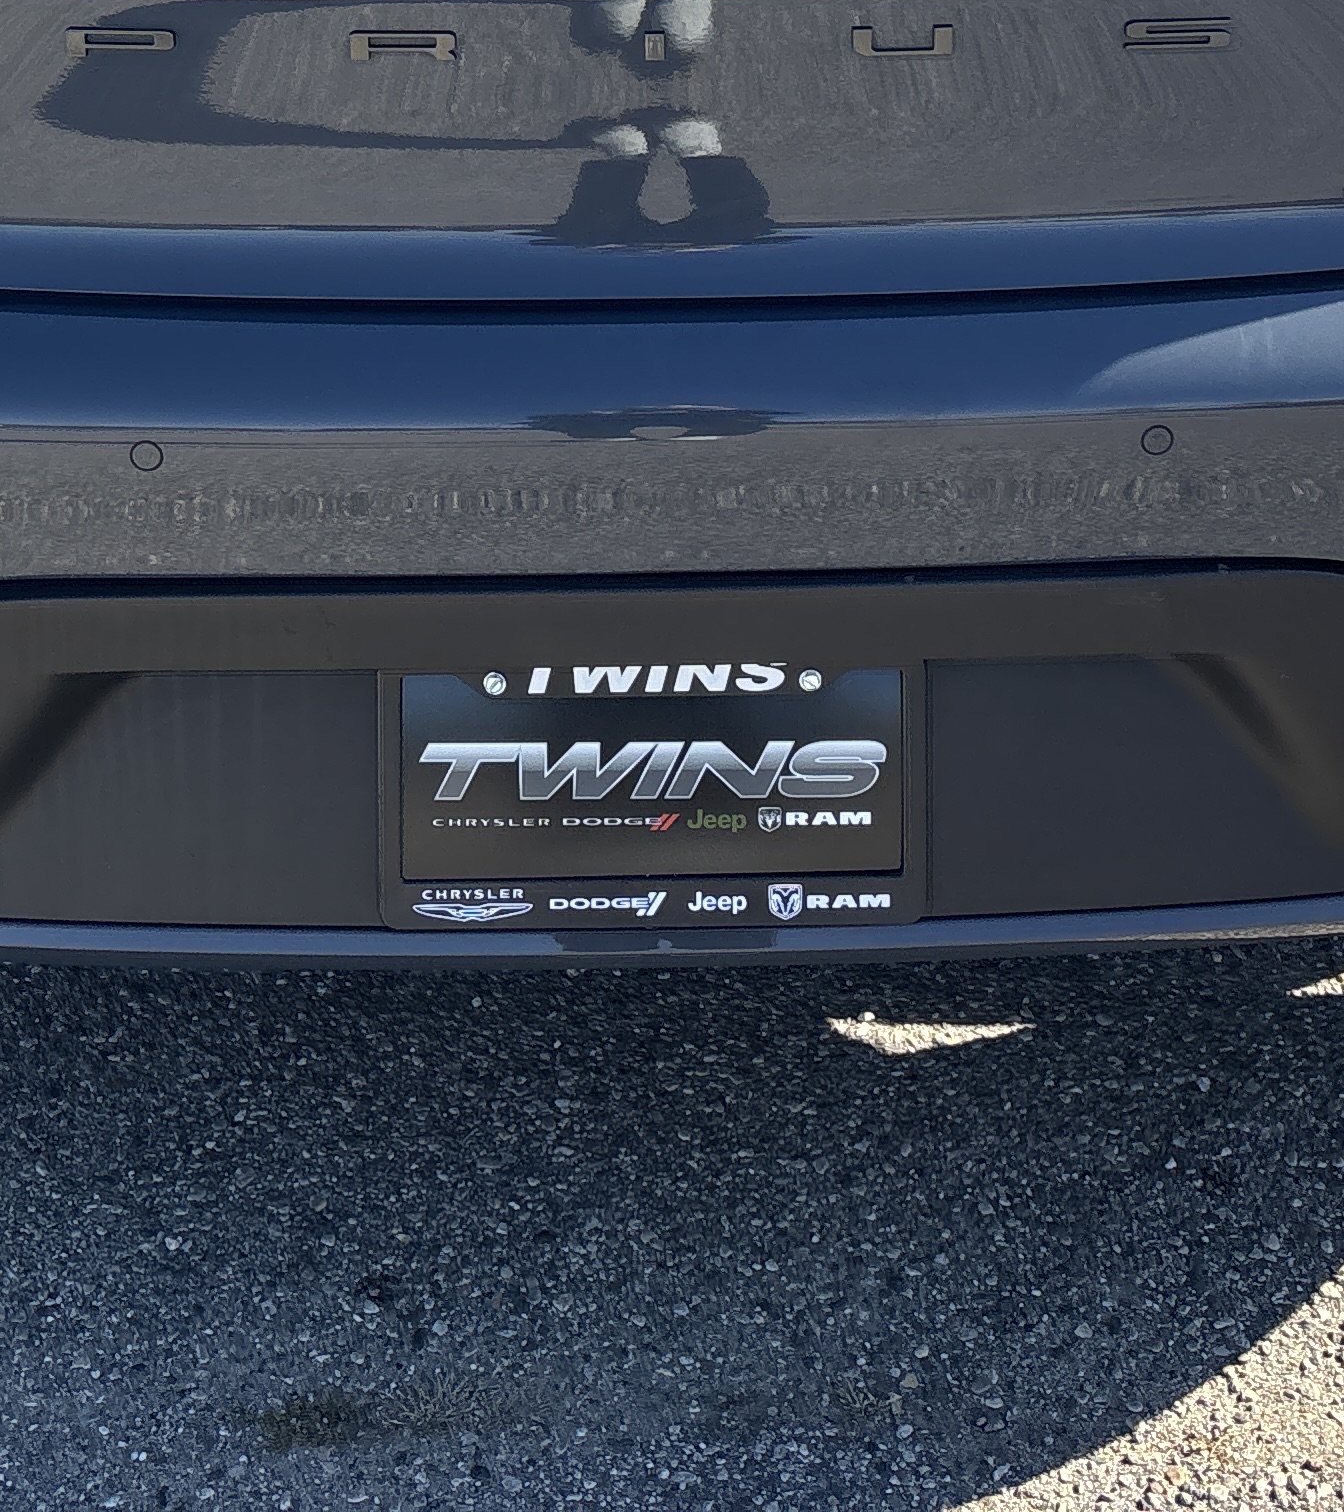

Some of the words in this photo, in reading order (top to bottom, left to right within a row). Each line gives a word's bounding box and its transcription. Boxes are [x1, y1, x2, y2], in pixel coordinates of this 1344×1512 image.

[65, 17, 1233, 61] PRIUS
[418, 739, 887, 801] TWINS
[432, 817, 551, 827] CHRYSLER
[562, 817, 662, 827] DODGE
[687, 809, 747, 832] Jeep
[785, 811, 872, 826] RAM
[421, 888, 525, 901] CHRYSLER
[549, 896, 650, 910] DODGE
[687, 890, 748, 915] Jeep
[806, 893, 891, 909] RAM
